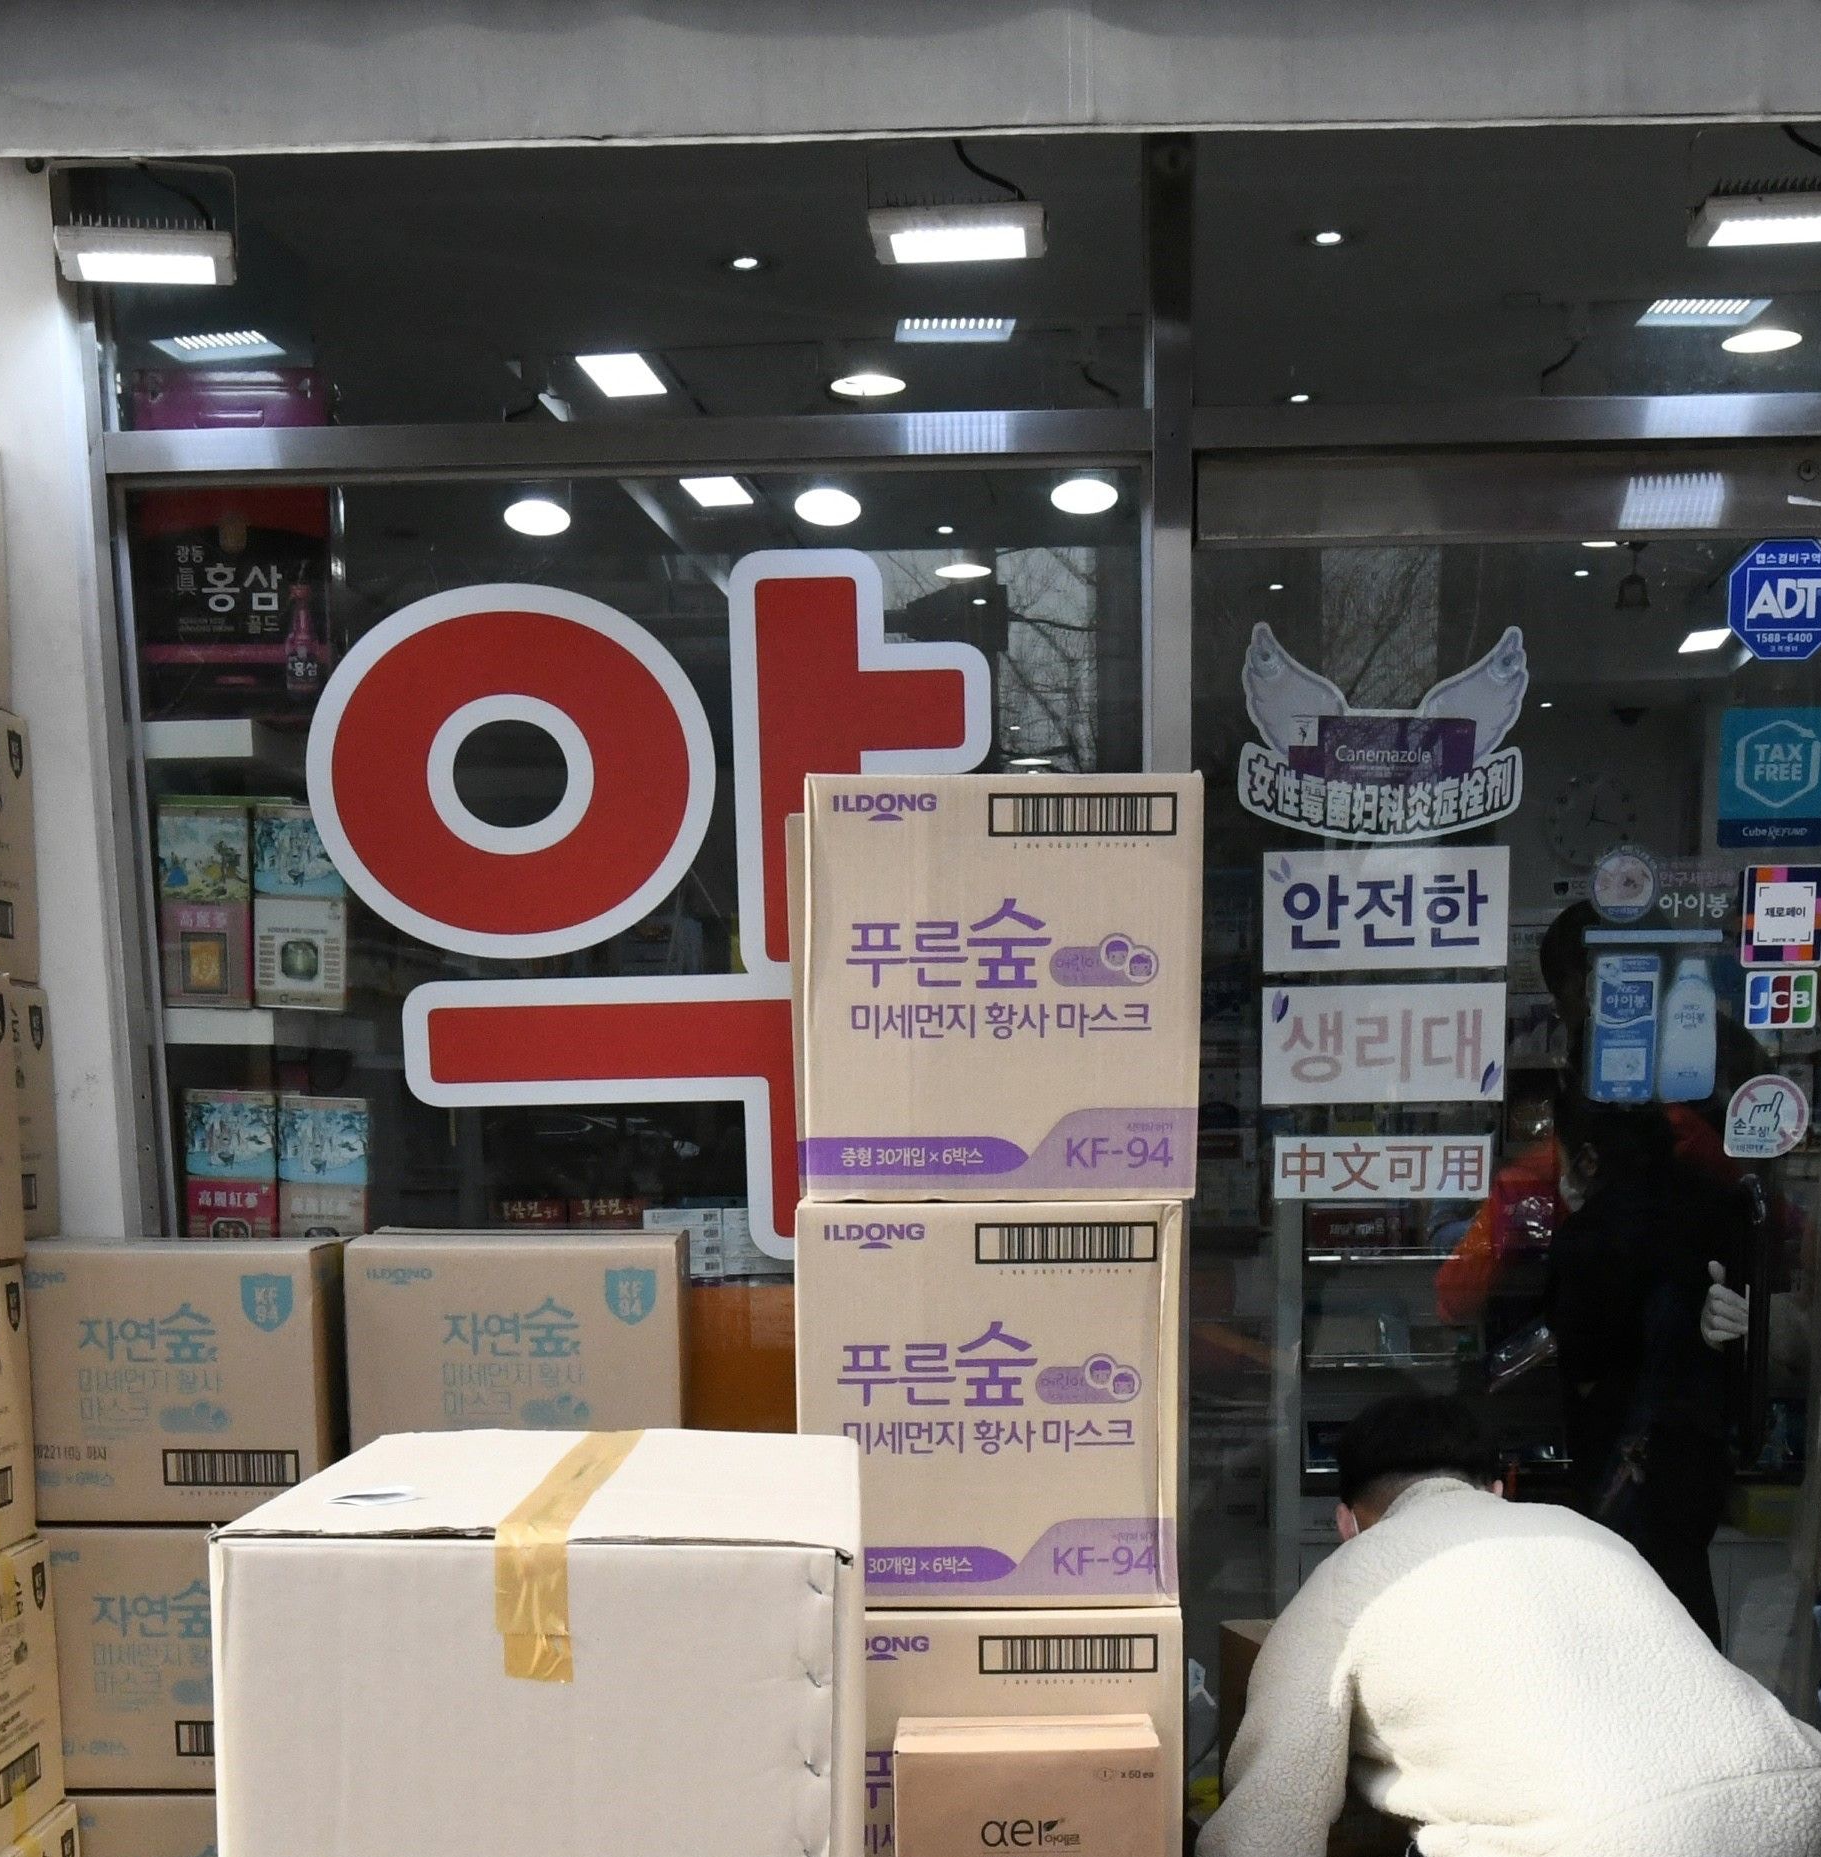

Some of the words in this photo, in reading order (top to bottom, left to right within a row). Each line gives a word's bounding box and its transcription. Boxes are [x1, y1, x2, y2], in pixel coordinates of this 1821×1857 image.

[201, 562, 283, 613] 홍삼
[246, 614, 280, 635] 골드
[1755, 632, 1814, 644] 1588-6400
[1334, 745, 1432, 764] Canemazole
[1754, 743, 1803, 763] TAX
[1753, 763, 1803, 782] FREE
[832, 792, 938, 822] ILDONG
[1742, 826, 1768, 837] Cube
[306, 549, 992, 1260] 약
[1282, 868, 1489, 951] 안전한
[1658, 892, 1730, 919] 아이봉
[1764, 906, 1807, 919] 제로페이
[845, 897, 1052, 990] 푸른숲
[1749, 990, 1811, 1010] JCB
[849, 1002, 977, 1040] 미세먼지
[984, 1001, 1050, 1040] 황사
[1054, 1002, 1153, 1039] 마스크
[1281, 1006, 1483, 1085] 생리대
[1733, 1120, 1748, 1136] 손
[839, 1147, 873, 1168] 중형
[875, 1146, 927, 1168] 30개입
[941, 1146, 984, 1167] 6박스
[1065, 1135, 1175, 1170] KF-94
[1280, 1143, 1485, 1193] 中文可用
[980, 1818, 1059, 1848] aer
[1044, 1833, 1081, 1847] 아에르
